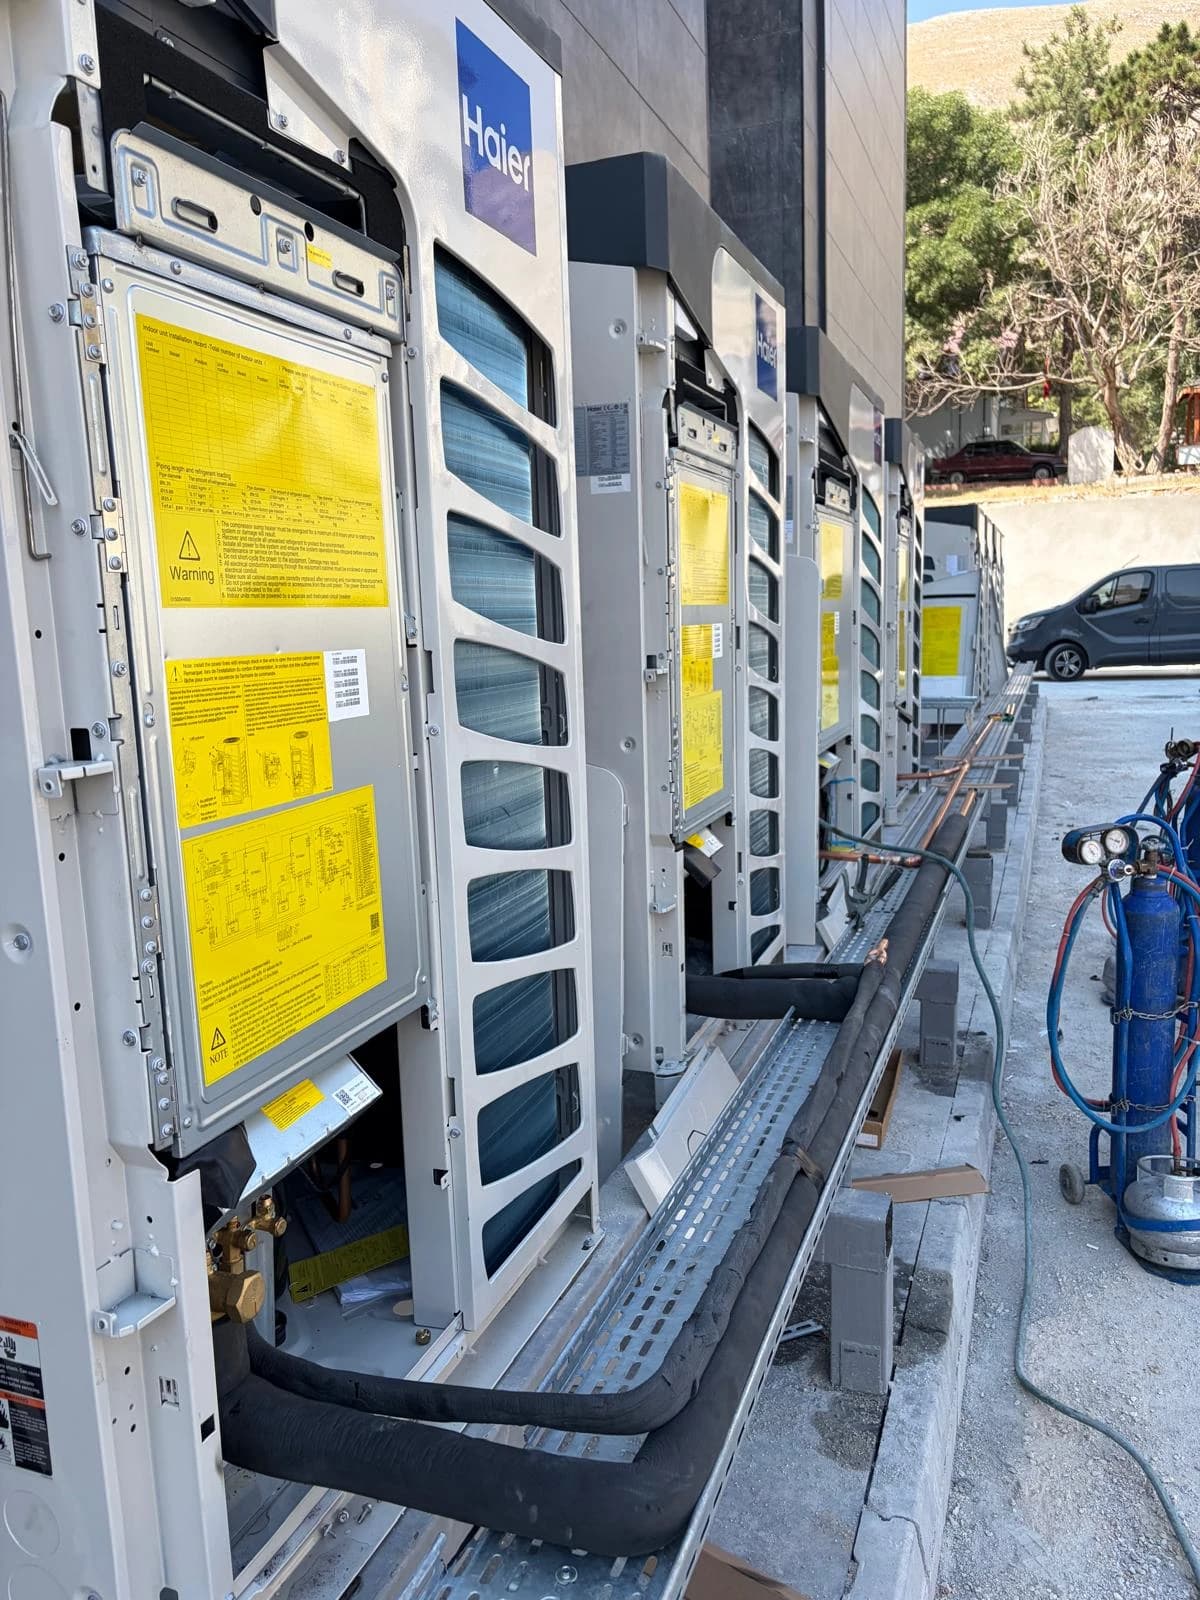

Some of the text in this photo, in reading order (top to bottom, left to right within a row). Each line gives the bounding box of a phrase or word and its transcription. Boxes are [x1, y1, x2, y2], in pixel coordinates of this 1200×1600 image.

[462, 93, 530, 192] Haier
[757, 329, 777, 368] Haier
[169, 566, 215, 585] Warning
[209, 1048, 229, 1067] NOTE
